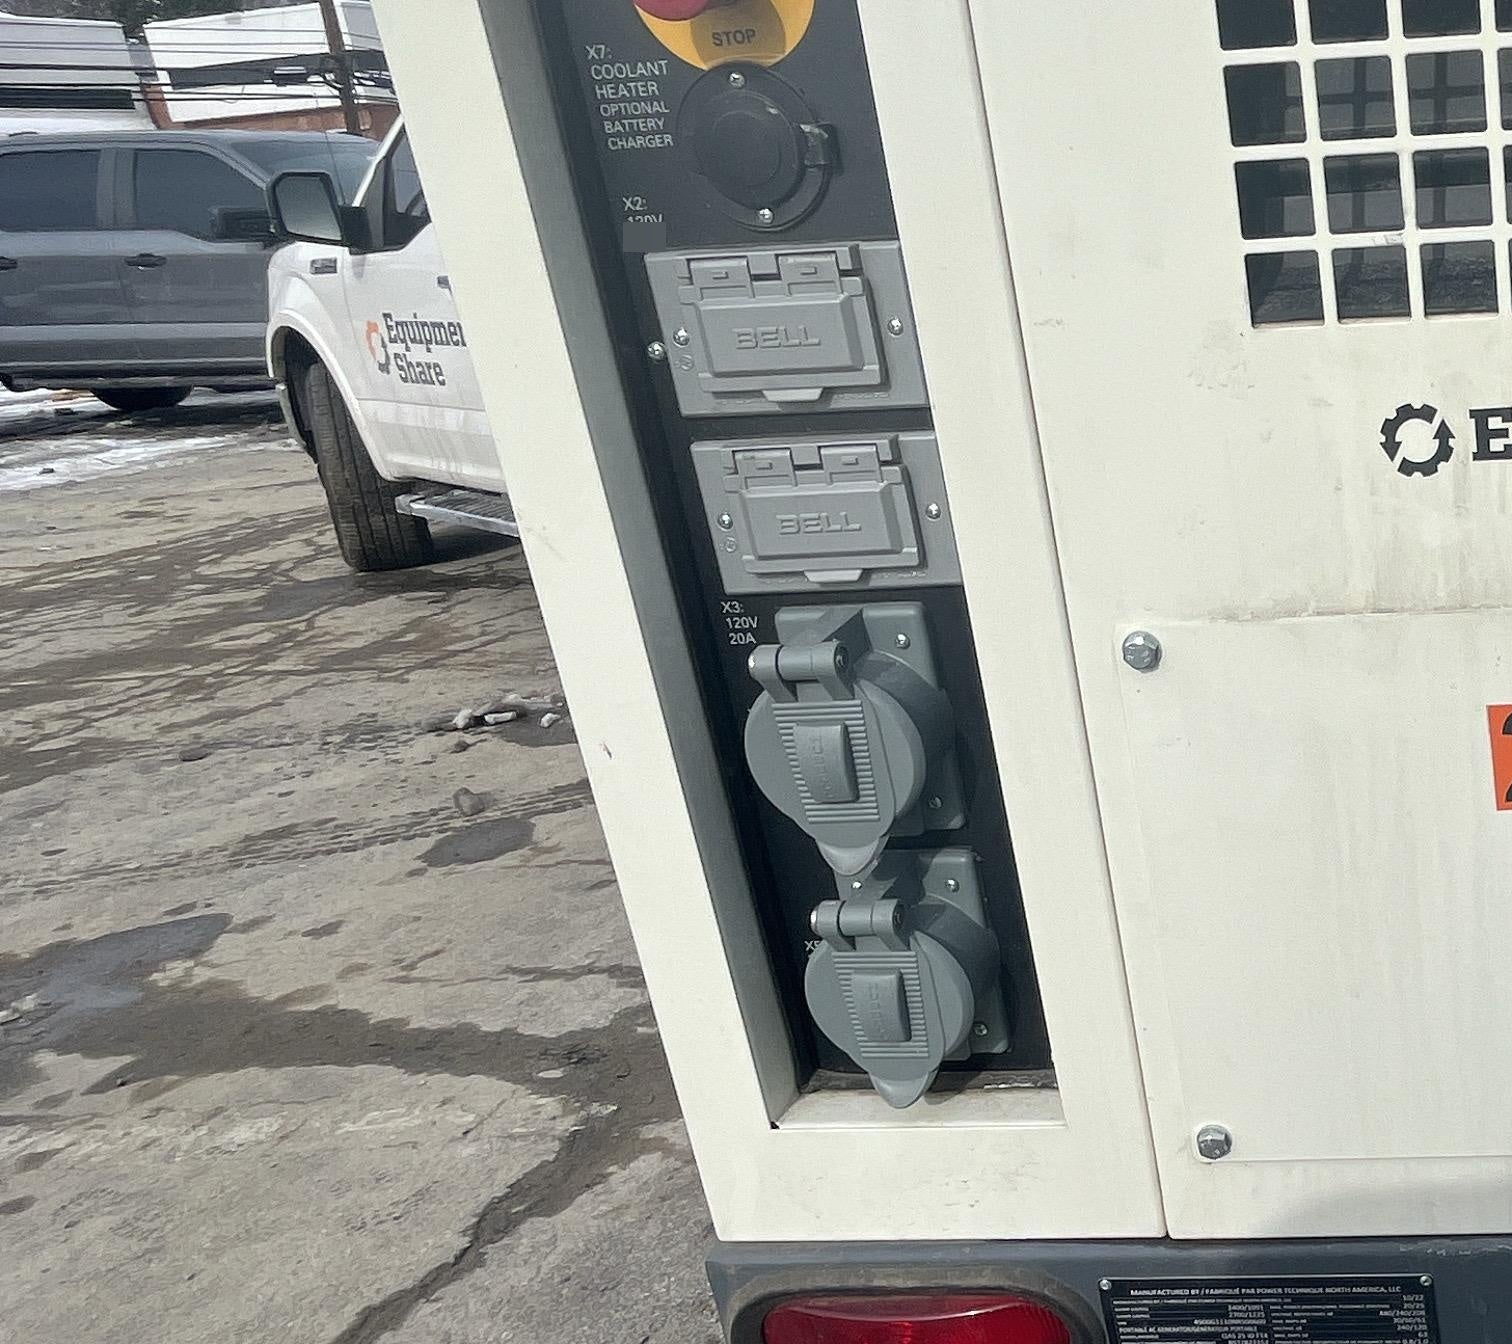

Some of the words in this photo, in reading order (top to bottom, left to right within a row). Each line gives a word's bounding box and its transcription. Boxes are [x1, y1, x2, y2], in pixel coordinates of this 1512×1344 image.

[711, 28, 756, 47] STOP
[585, 44, 613, 60] X7:
[590, 59, 669, 80] COOLANT
[594, 80, 660, 100] HEATER
[599, 100, 671, 117] OPTIONAL
[603, 116, 666, 134] BATTERY
[607, 133, 675, 151] CHARGER
[621, 195, 649, 212] X2:
[735, 324, 821, 350] BELL
[393, 352, 446, 386] Share
[775, 511, 862, 535] BELL
[720, 600, 745, 614] X3:
[725, 615, 758, 630] 120V
[728, 632, 758, 645] 20A
